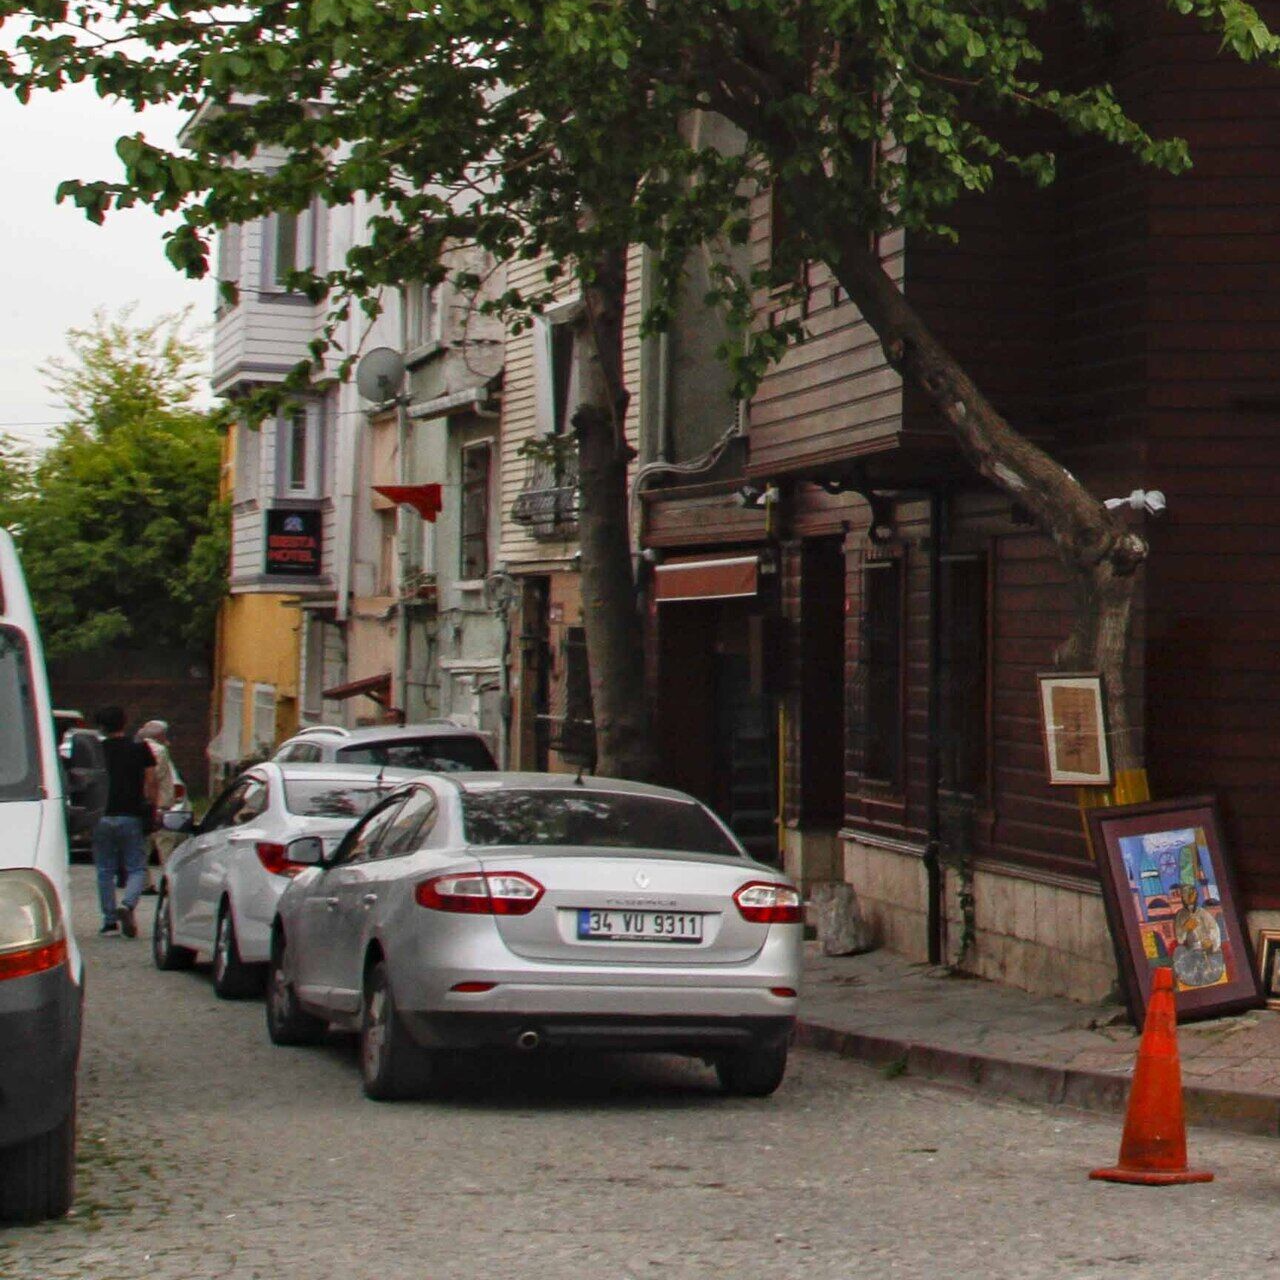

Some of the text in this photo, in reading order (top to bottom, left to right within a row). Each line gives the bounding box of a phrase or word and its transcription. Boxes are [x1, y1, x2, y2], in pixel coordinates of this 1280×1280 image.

[267, 549, 315, 563] HOTEL
[591, 913, 697, 935] 34 VU 9311
